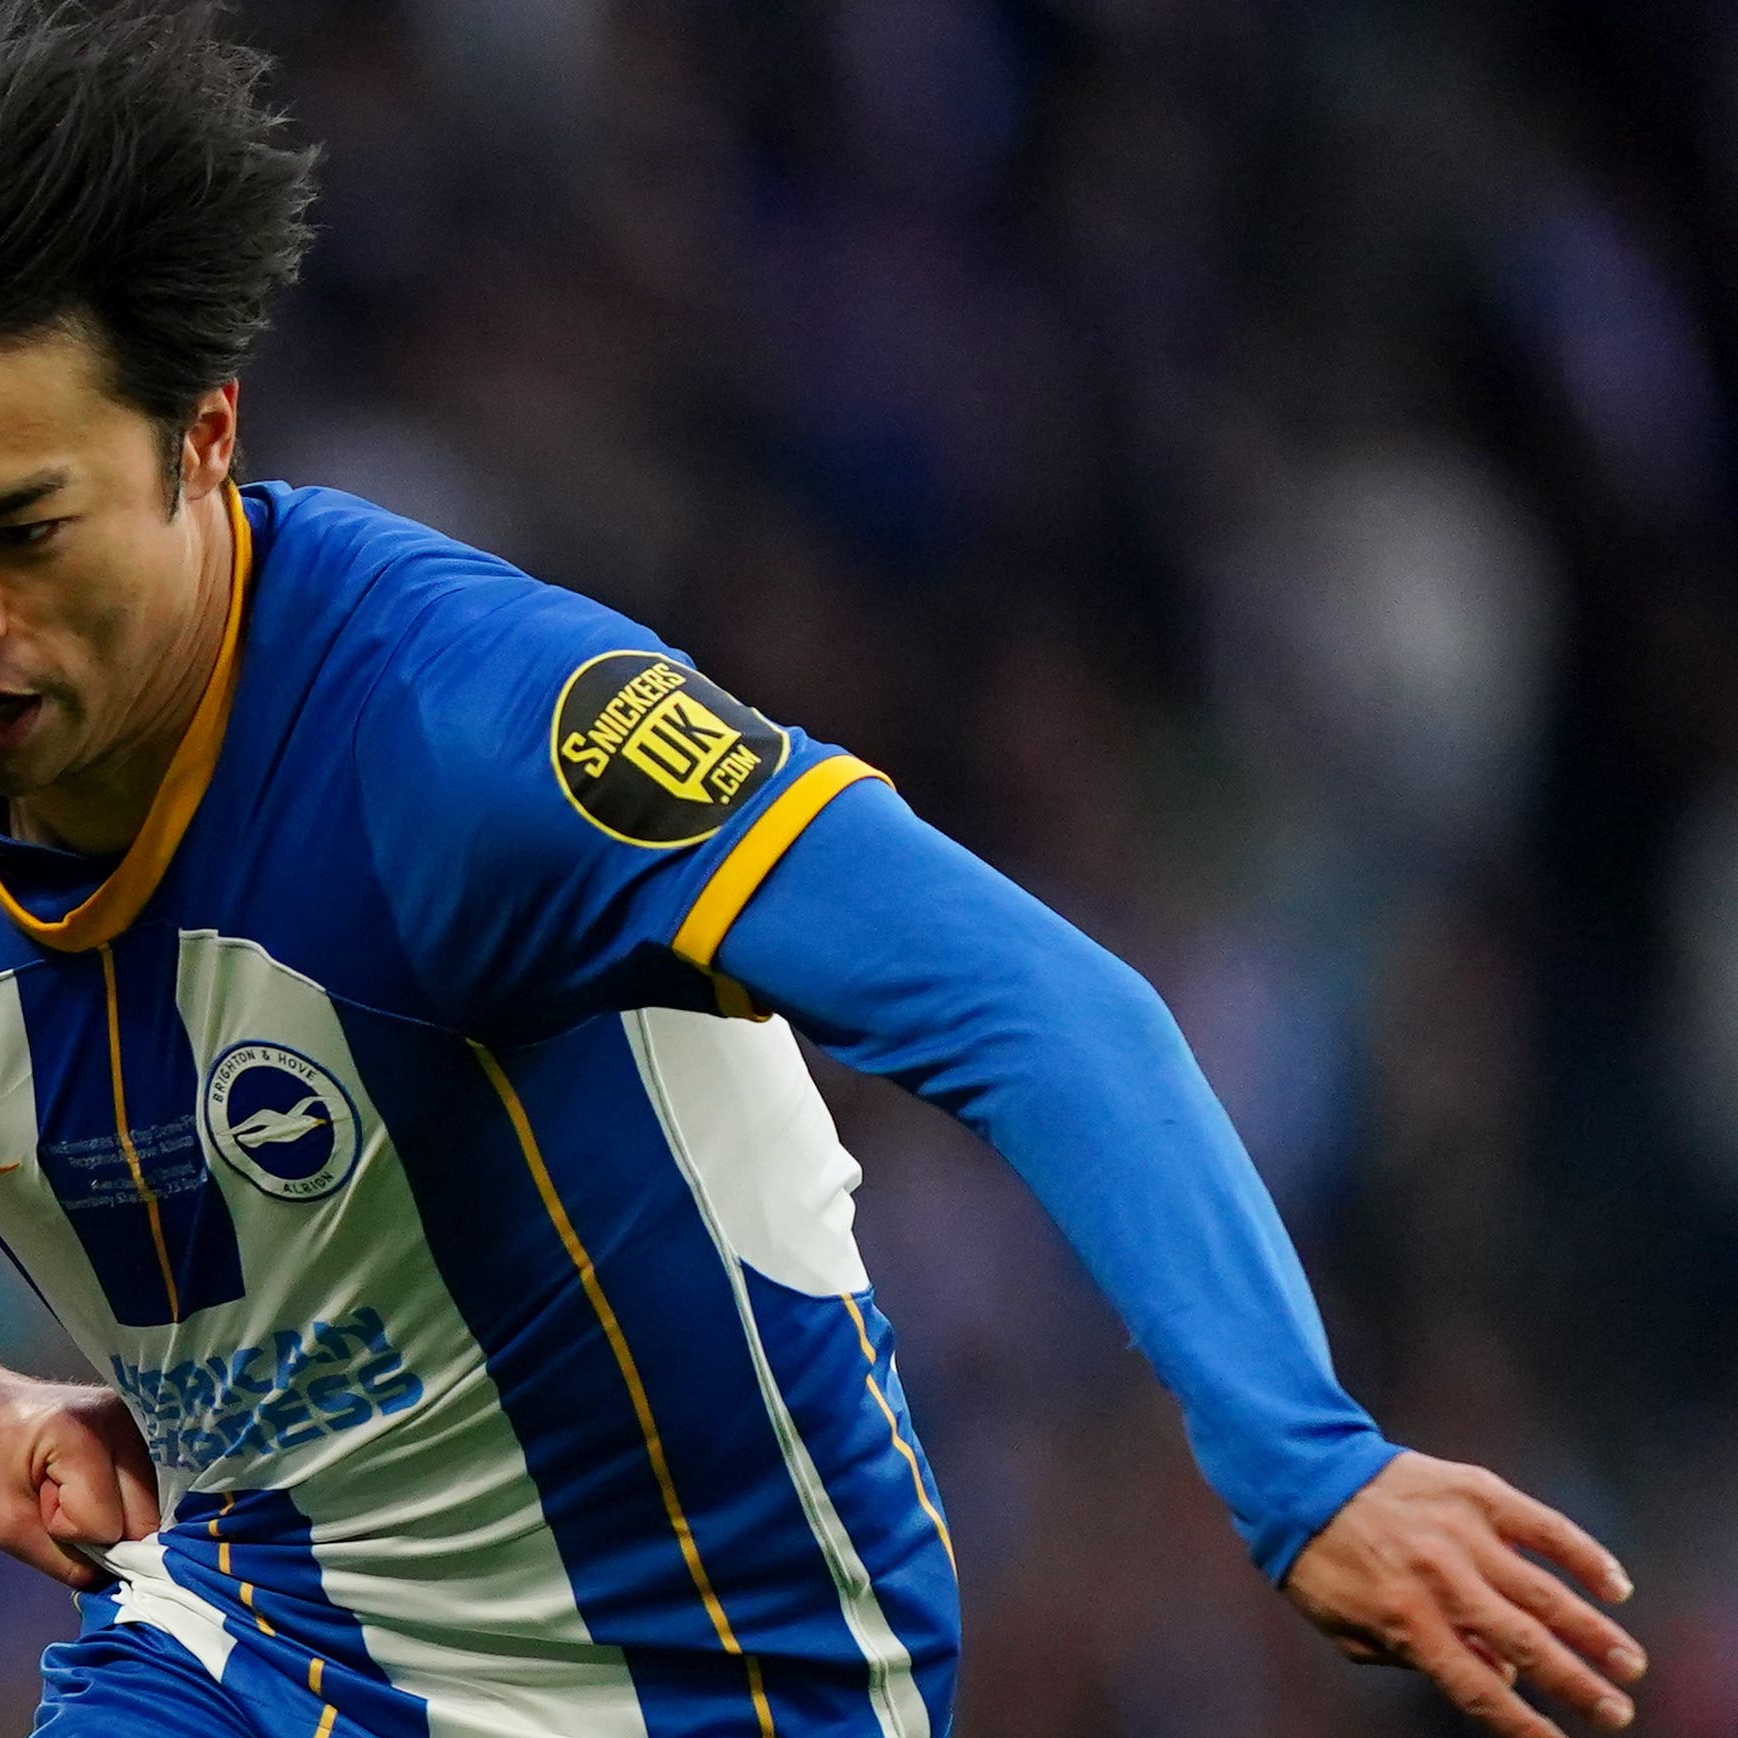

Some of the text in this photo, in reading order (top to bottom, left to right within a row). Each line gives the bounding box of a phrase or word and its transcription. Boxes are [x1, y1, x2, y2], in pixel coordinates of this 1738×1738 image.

[561, 661, 686, 778] SNICKERS
[636, 703, 726, 784] UK
[213, 1050, 318, 1103] BRIGHTON & HOVE
[281, 1171, 334, 1194] ALBION
